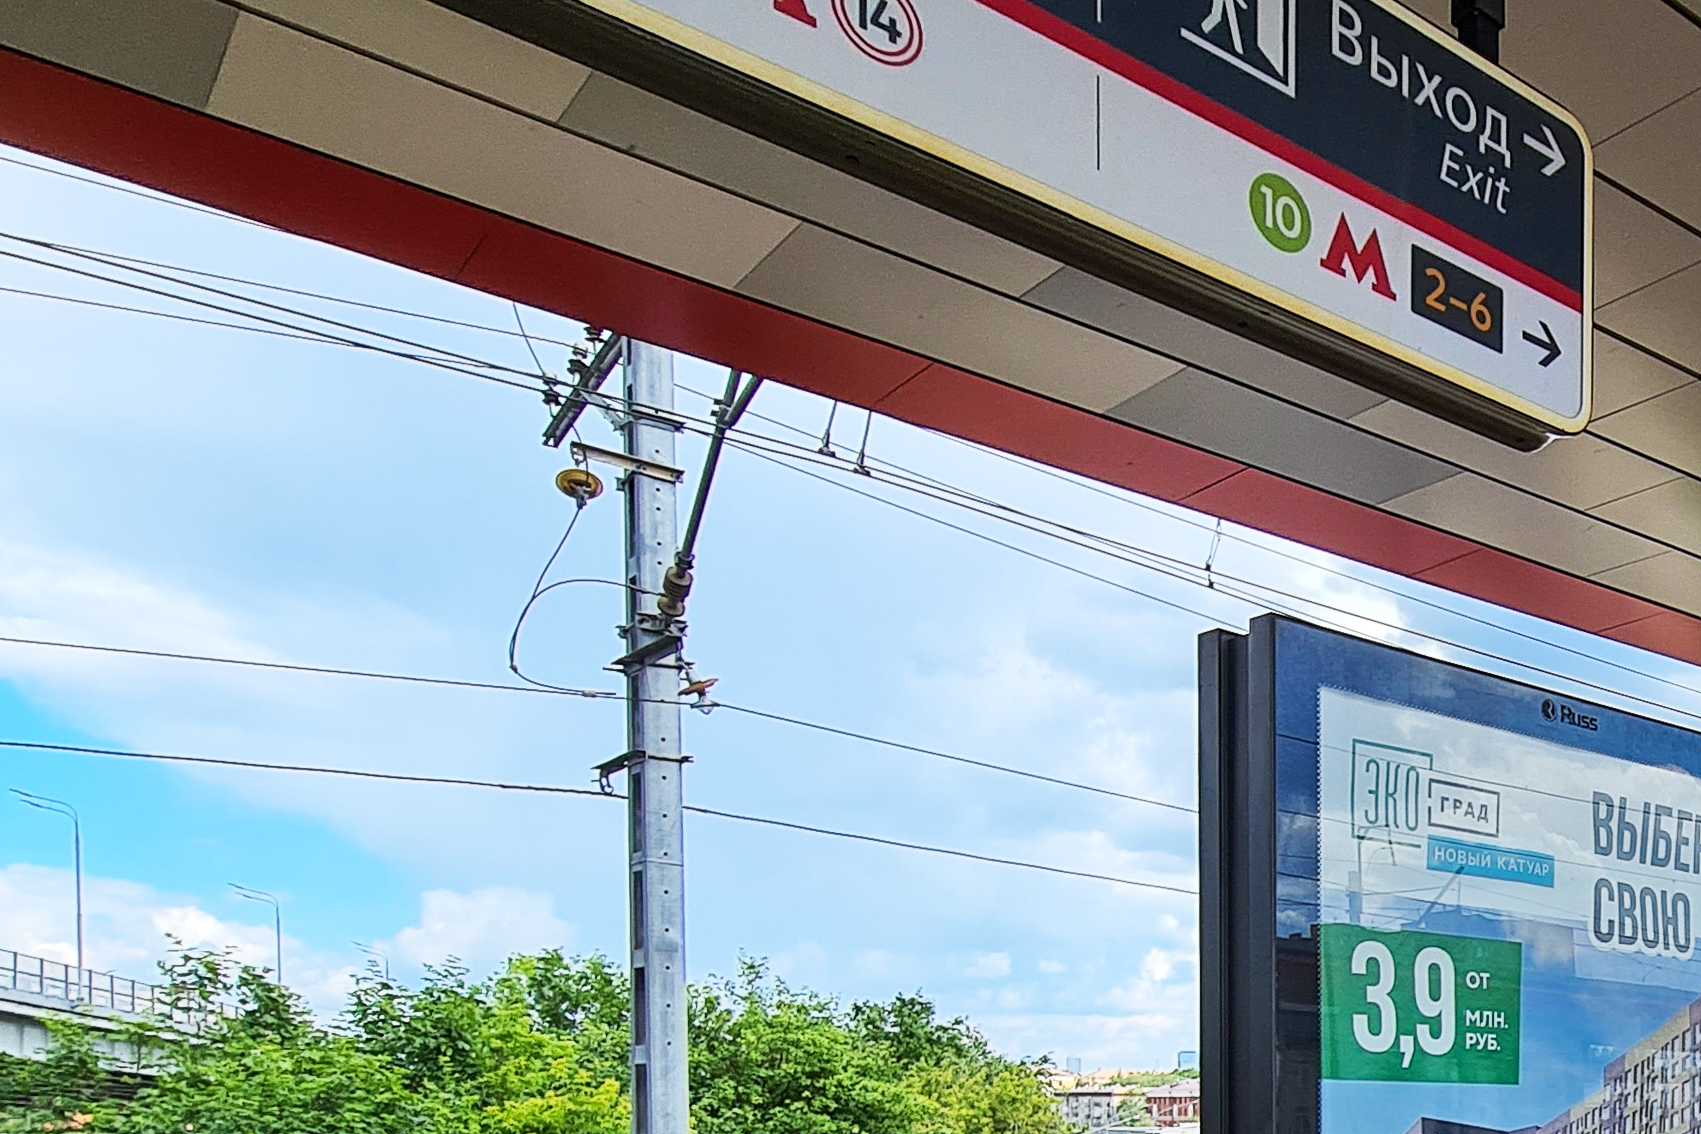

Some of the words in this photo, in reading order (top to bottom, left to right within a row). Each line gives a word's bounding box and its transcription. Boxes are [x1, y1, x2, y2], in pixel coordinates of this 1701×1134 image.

[858, 0, 903, 45] 14
[1331, 0, 1511, 169] Выход
[1439, 142, 1511, 214] Exit
[1259, 184, 1303, 240] 10
[1560, 704, 1599, 732] Russ
[1364, 757, 1420, 832] ЭКО
[1440, 795, 1489, 824] ГРАД
[1433, 846, 1492, 869] НОВЫЙ
[1497, 856, 1550, 877] КАТУАР
[1593, 877, 1691, 954] СВОЮ
[1465, 971, 1491, 990] ОТ
[1351, 940, 1456, 1069] 3,9
[1465, 1009, 1509, 1030] МЛН.
[1465, 1032, 1501, 1051] РУБ.
